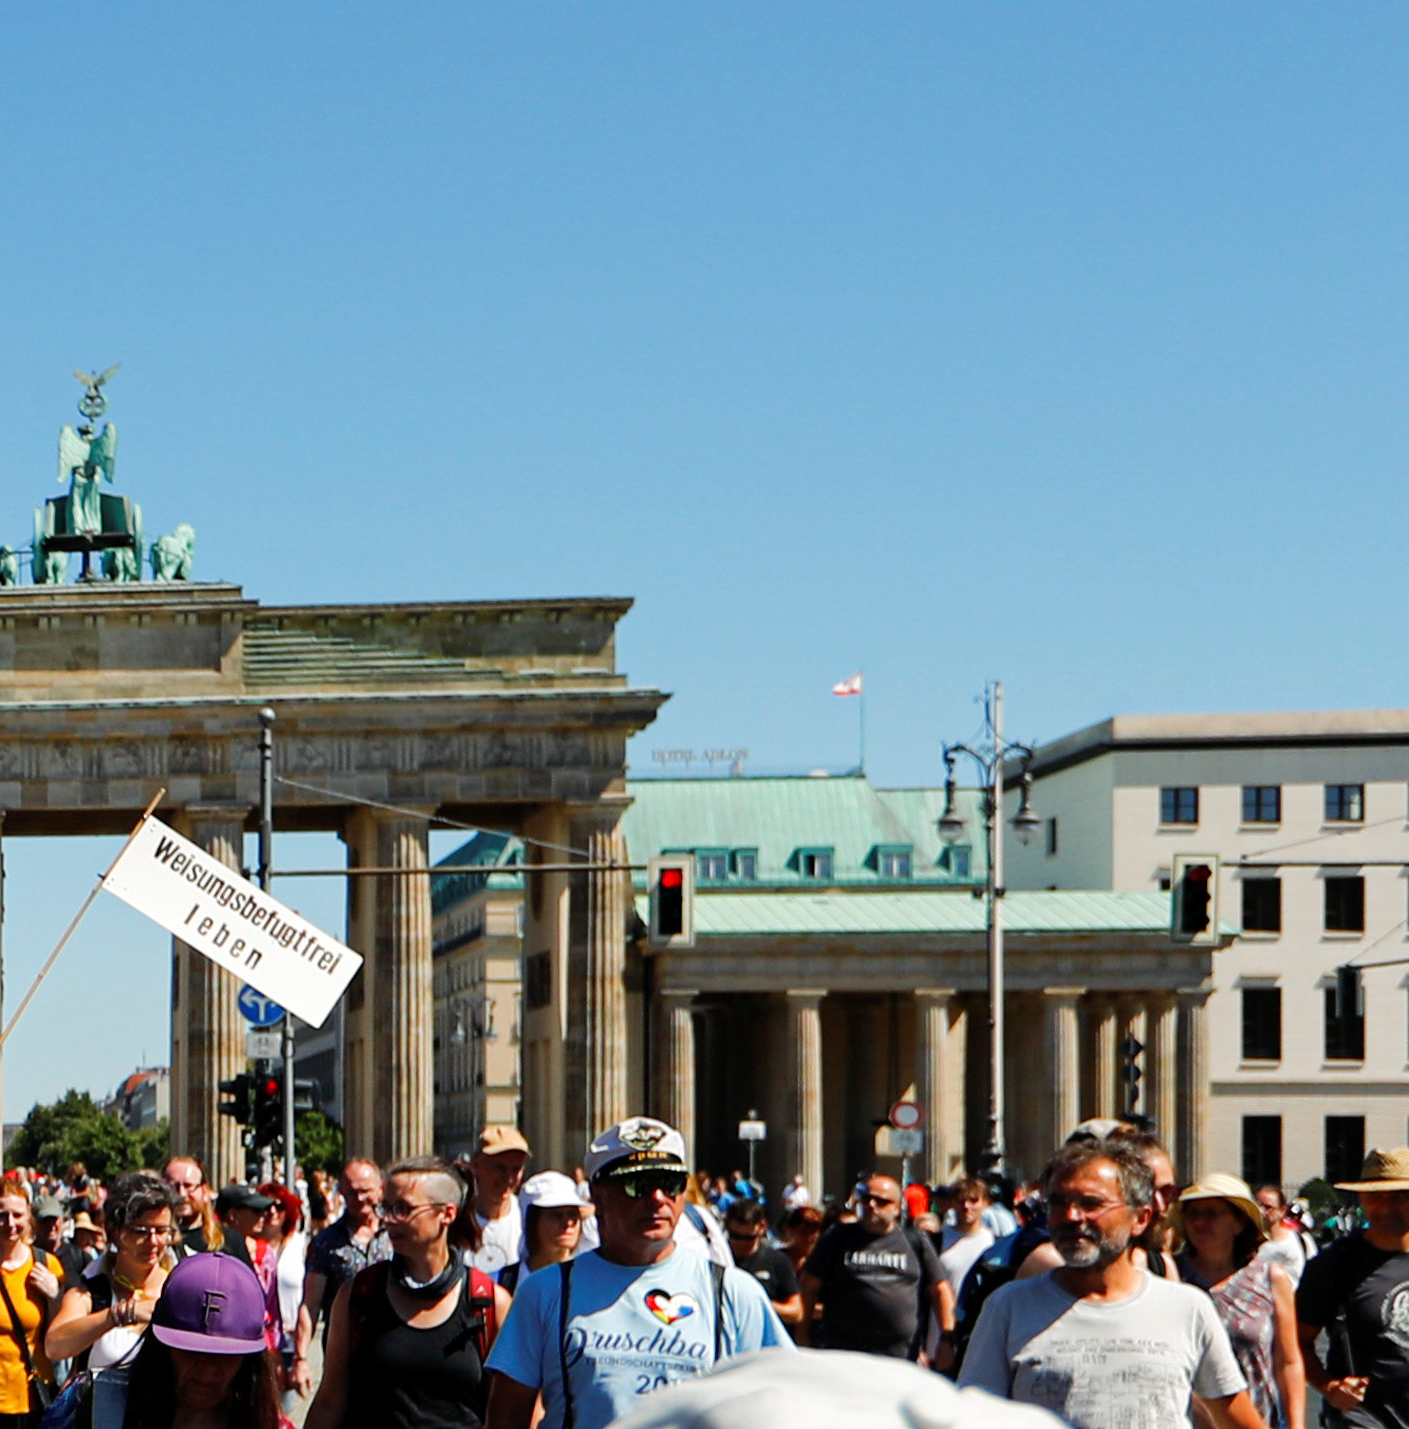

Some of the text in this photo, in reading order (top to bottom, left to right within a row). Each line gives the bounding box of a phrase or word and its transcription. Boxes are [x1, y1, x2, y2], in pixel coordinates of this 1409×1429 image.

[153, 835, 343, 975] Weisungsbefugtfrei
[184, 903, 263, 970] leben
[203, 1290, 228, 1328] F
[564, 1327, 709, 1369] Druschba
